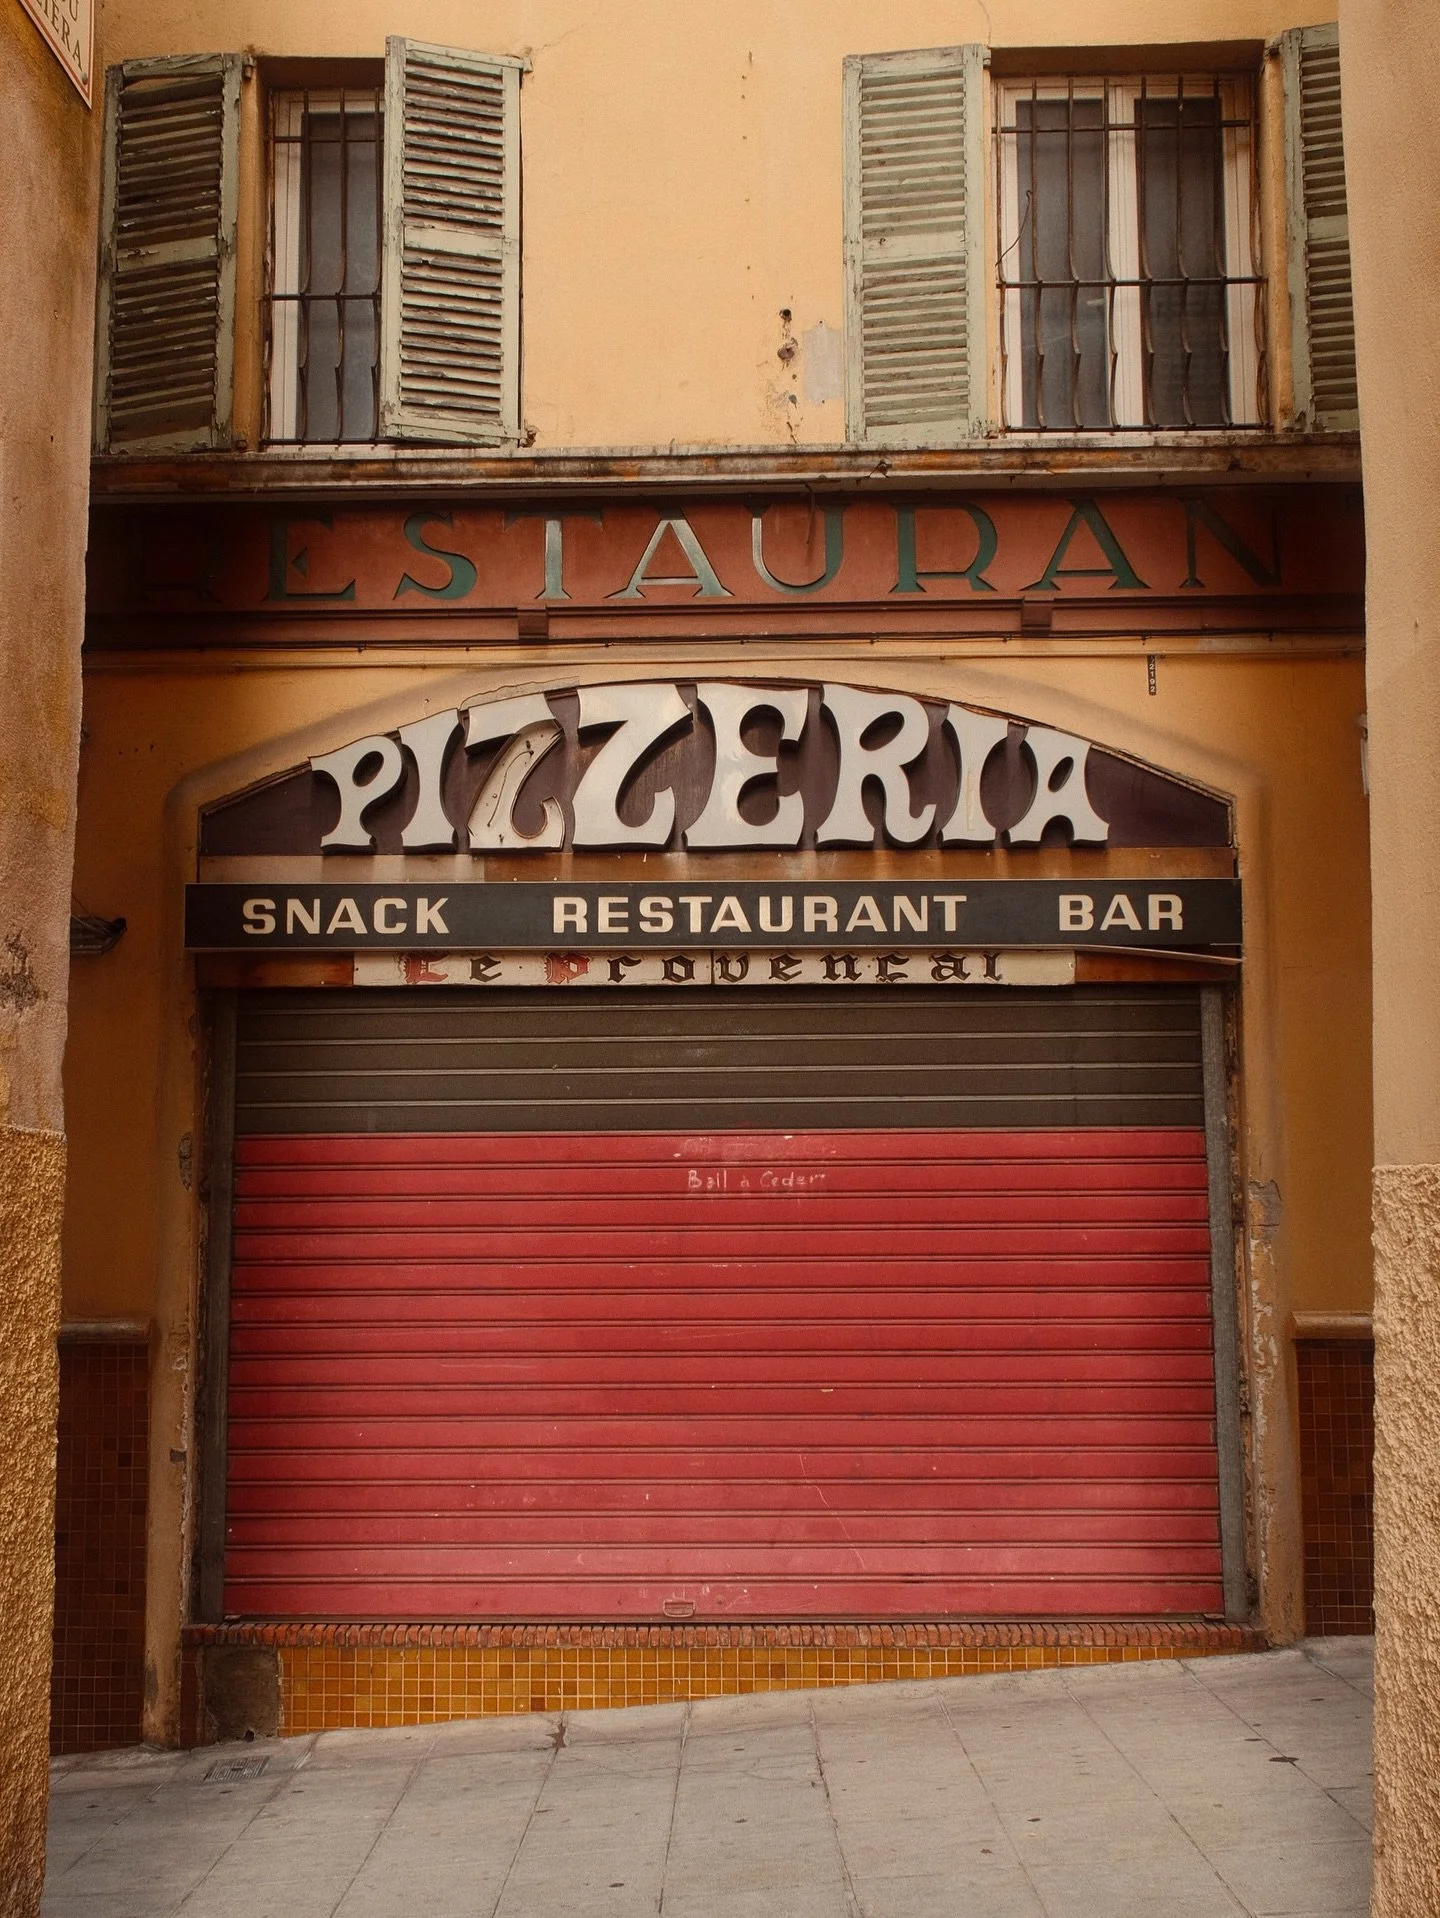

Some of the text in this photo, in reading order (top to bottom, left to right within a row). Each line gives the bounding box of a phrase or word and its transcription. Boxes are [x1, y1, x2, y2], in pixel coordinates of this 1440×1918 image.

[309, 682, 1110, 852] PIZZERIA
[242, 893, 1184, 935] SNACK RESTAURANT BAR
